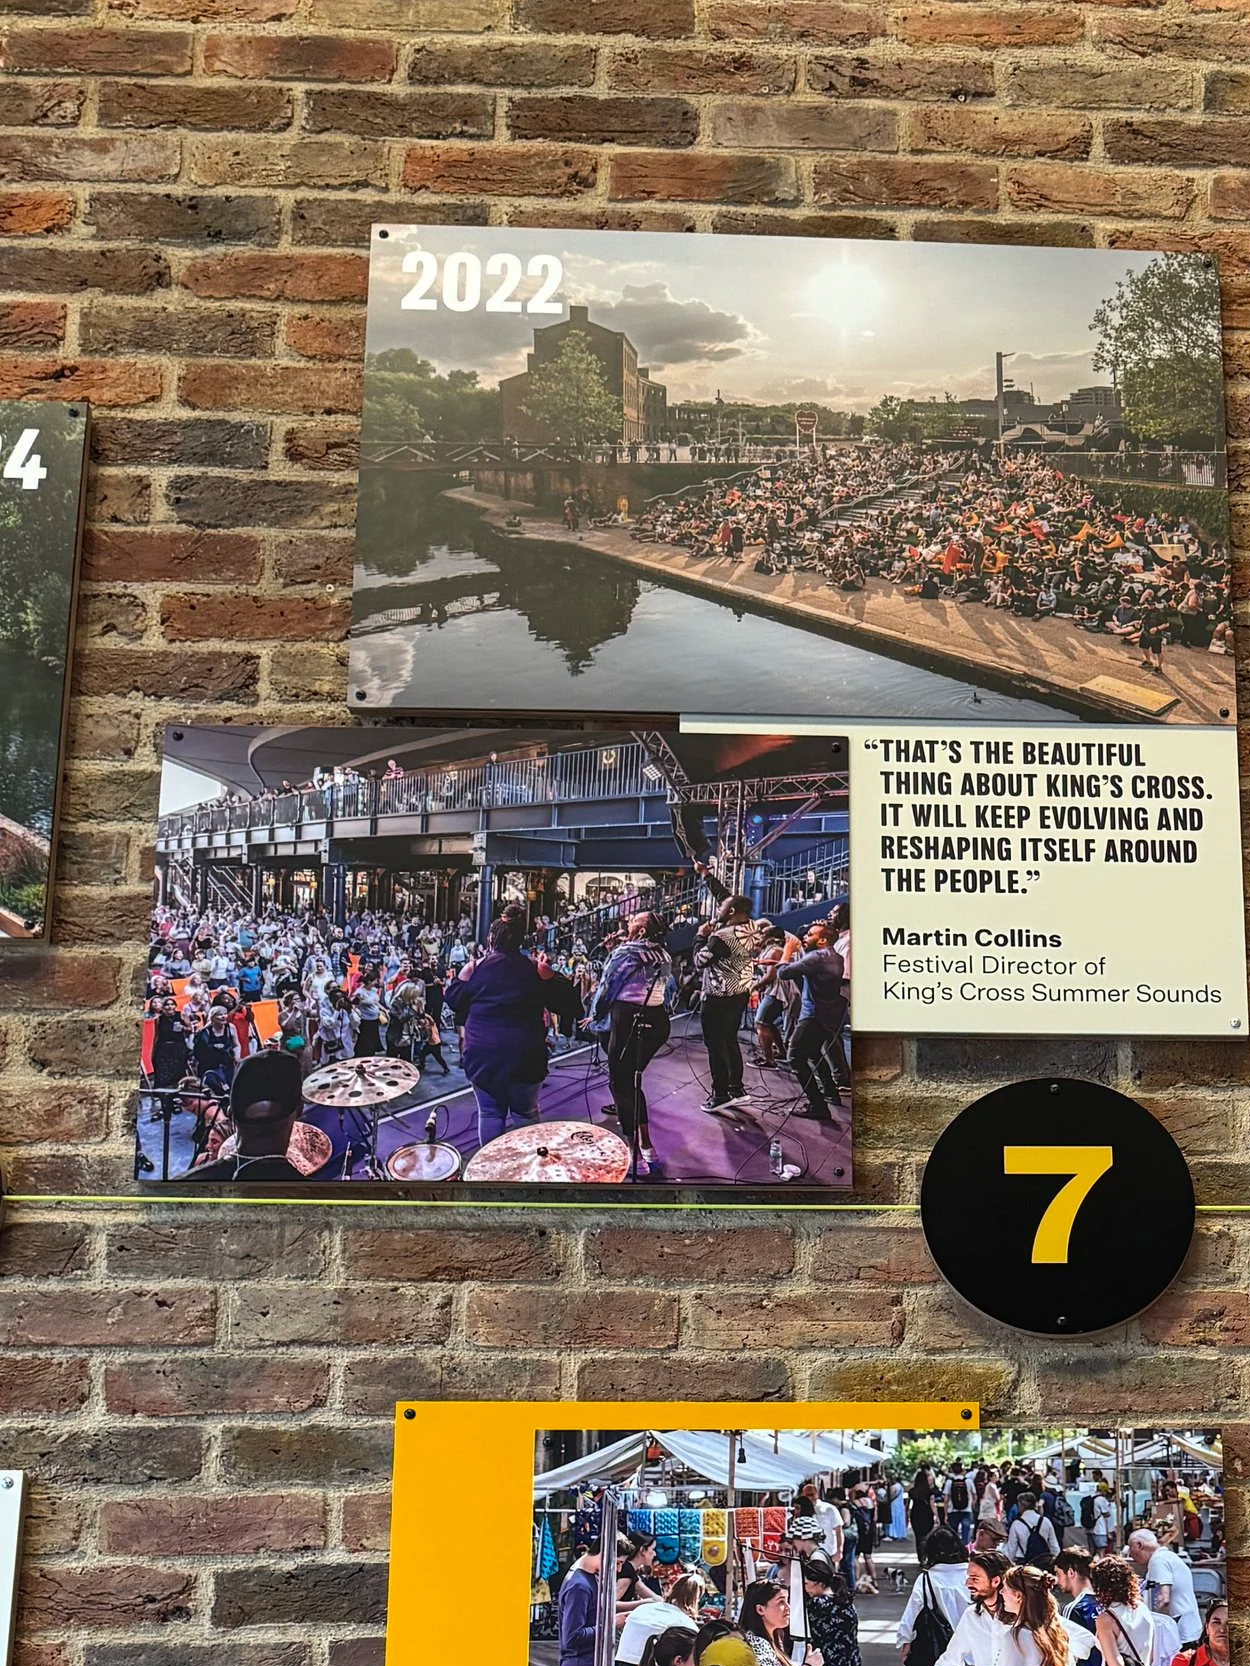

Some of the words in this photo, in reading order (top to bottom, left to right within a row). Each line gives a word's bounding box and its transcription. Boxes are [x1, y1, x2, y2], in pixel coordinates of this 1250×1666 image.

[400, 250, 564, 315] 2022
[0, 427, 48, 491] 4
[969, 740, 1014, 765] THE
[1022, 741, 1146, 767] BEAUTIFUL
[879, 770, 952, 796] THING
[960, 772, 1038, 797] ABOUT
[1131, 774, 1213, 800] CROSS.
[880, 803, 904, 827] IT
[911, 803, 967, 828] WILL
[975, 804, 1031, 829] KEEP
[1039, 805, 1149, 831] EVOLVING
[1156, 807, 1204, 832] AND
[881, 835, 1012, 862] RESHAPING
[1020, 837, 1096, 863] ITSELF
[1104, 838, 1198, 864] AROUND
[880, 867, 926, 893] THE
[882, 927, 968, 947] Martin
[974, 928, 1062, 948] Collins
[883, 954, 973, 974] Festival
[982, 955, 1078, 975] Director
[1084, 956, 1106, 976] of
[959, 982, 1025, 1002] Cross
[1032, 982, 1131, 1003] Summer
[1136, 983, 1222, 1004] Sounds
[1003, 1145, 1114, 1265] 7
